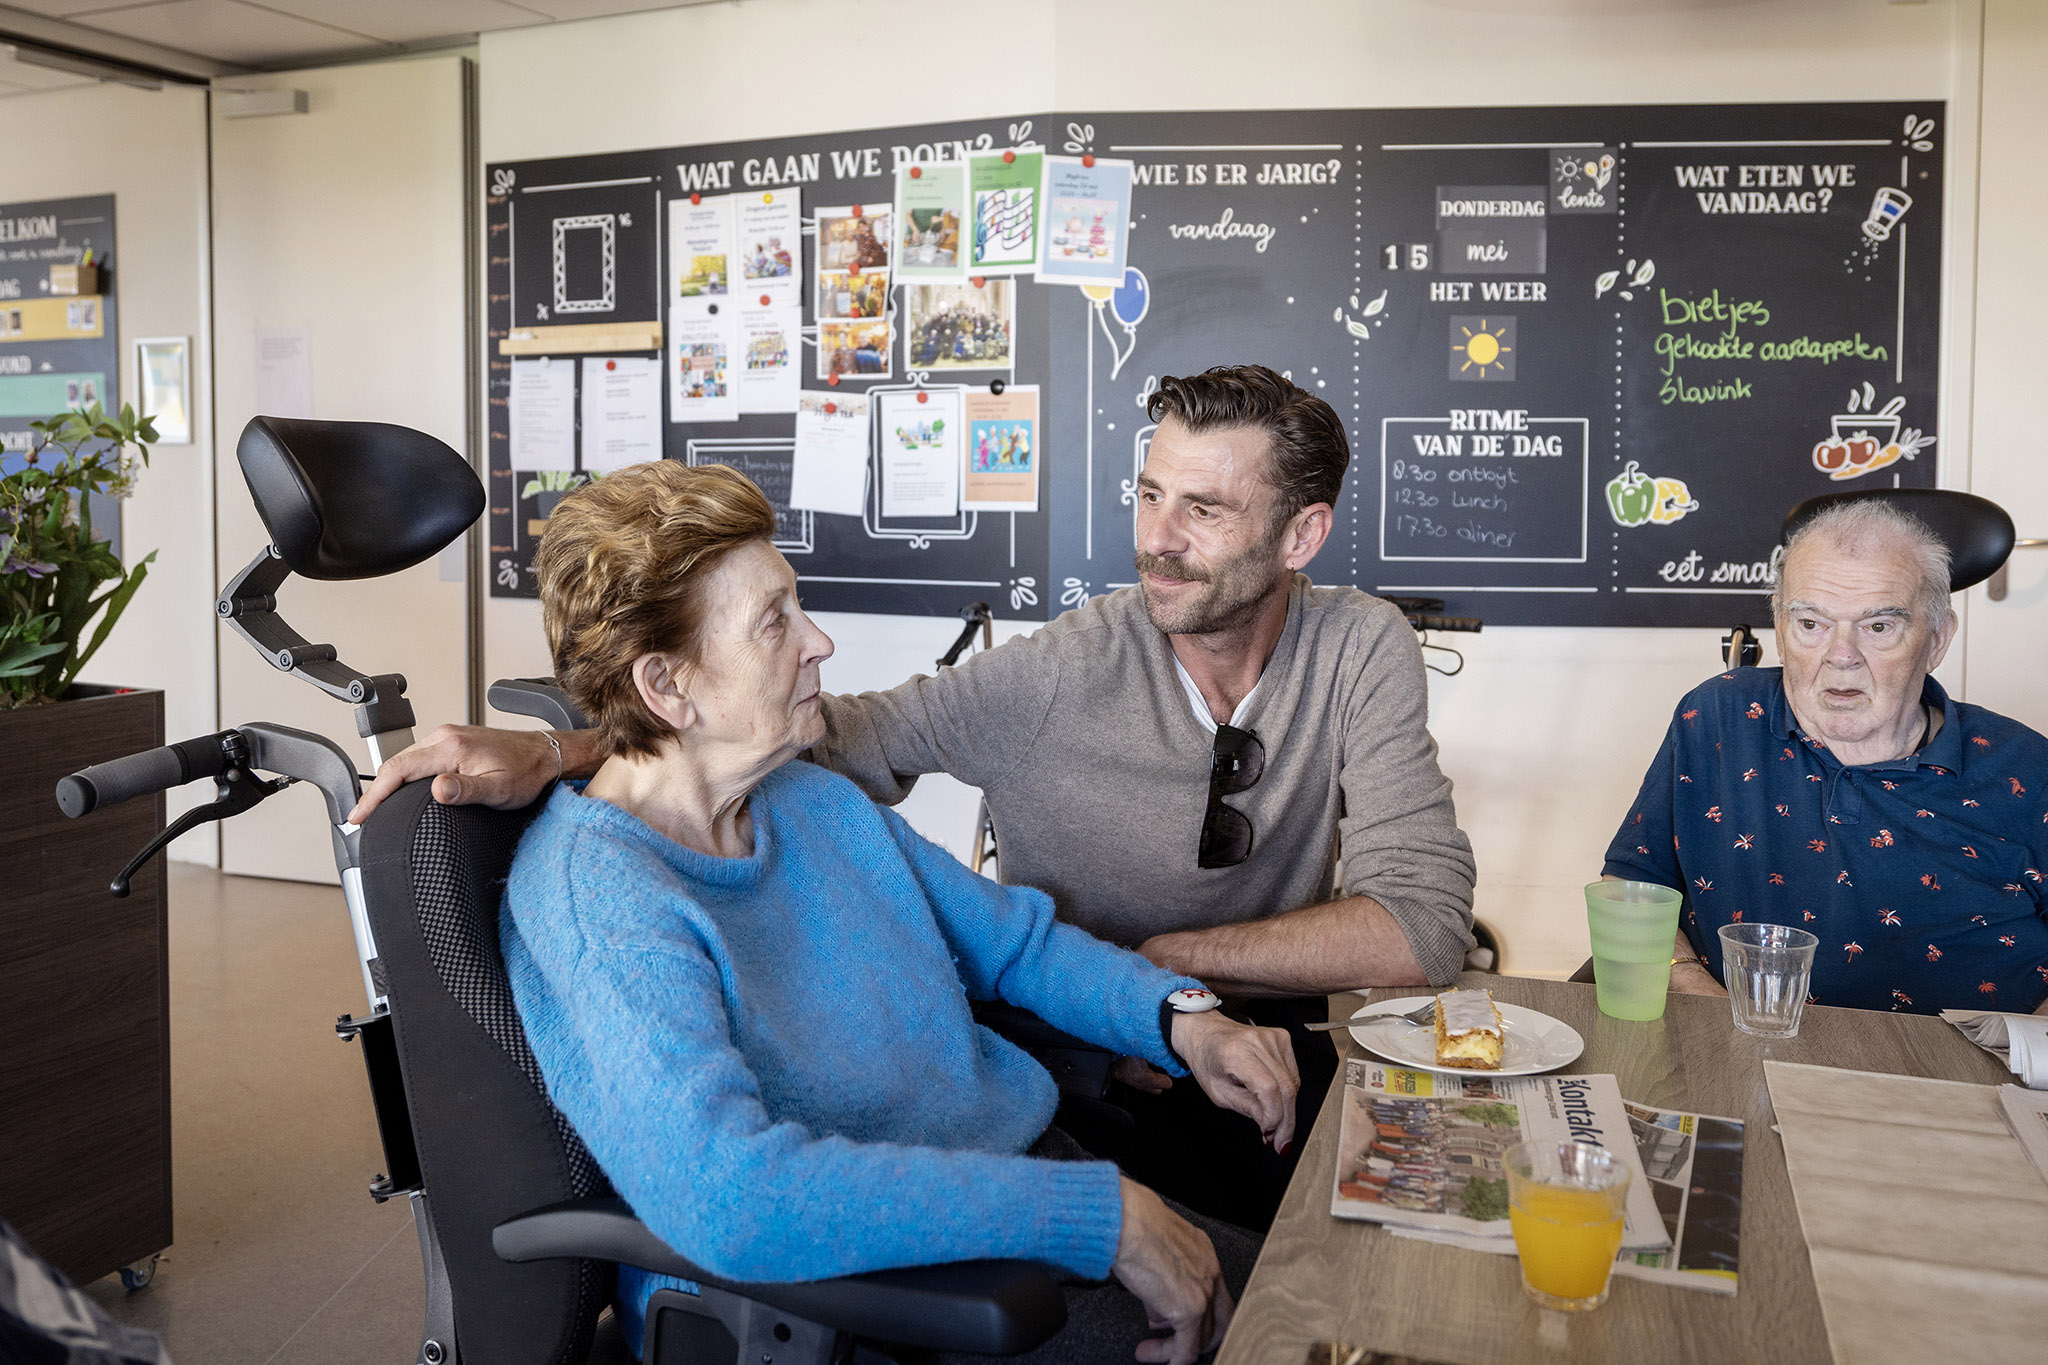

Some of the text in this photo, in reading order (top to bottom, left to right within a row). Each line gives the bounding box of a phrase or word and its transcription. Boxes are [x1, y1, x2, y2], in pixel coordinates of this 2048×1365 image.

[677, 160, 735, 192] WAT
[743, 153, 821, 187] GAAN
[830, 148, 882, 180] WE
[1131, 159, 1341, 186] WIE IS ER JARIG?
[1675, 165, 1856, 187] WAT ETEN WE
[1440, 200, 1546, 217] DONDERDAG
[1557, 185, 1606, 209] lente
[1696, 188, 1833, 214] VANDAAG?
[0, 214, 58, 243] ELKOM
[1169, 207, 1276, 253] vandaag
[1466, 239, 1509, 262] mei
[1430, 281, 1547, 302] HET WEER
[1659, 287, 1770, 339] bietjes
[840, 410, 854, 419] TEA
[1449, 409, 1529, 432] RITME
[1413, 434, 1563, 457] VAN DE DAG
[1392, 458, 1437, 482] 8.30
[1395, 487, 1439, 508] 12.30
[1397, 515, 1517, 549] 17.30 diner
[1657, 549, 1705, 583] eet
